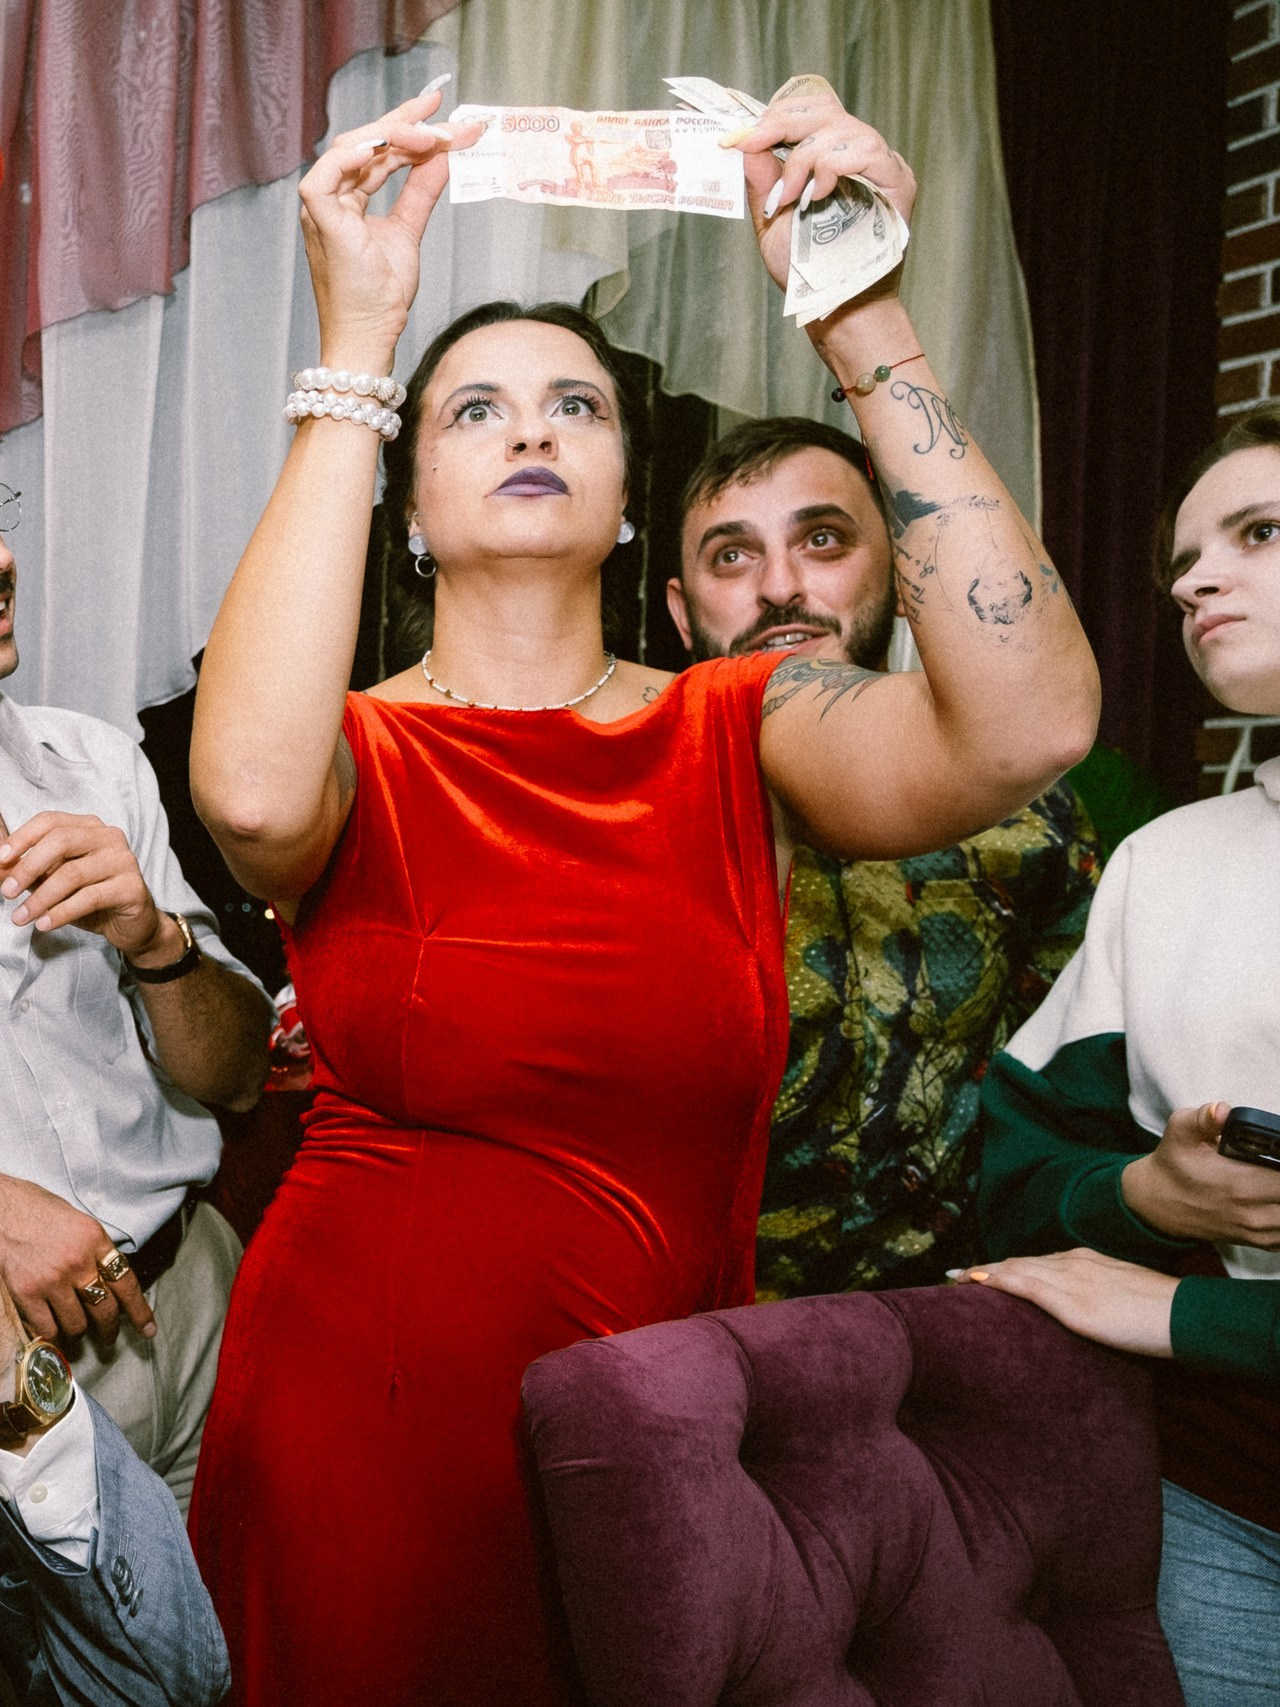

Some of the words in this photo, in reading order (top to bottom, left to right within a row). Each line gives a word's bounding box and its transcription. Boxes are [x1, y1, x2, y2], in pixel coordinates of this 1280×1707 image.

[502, 115, 560, 133] 5000
[634, 117, 670, 127] БАНКА
[812, 213, 841, 245] 10
